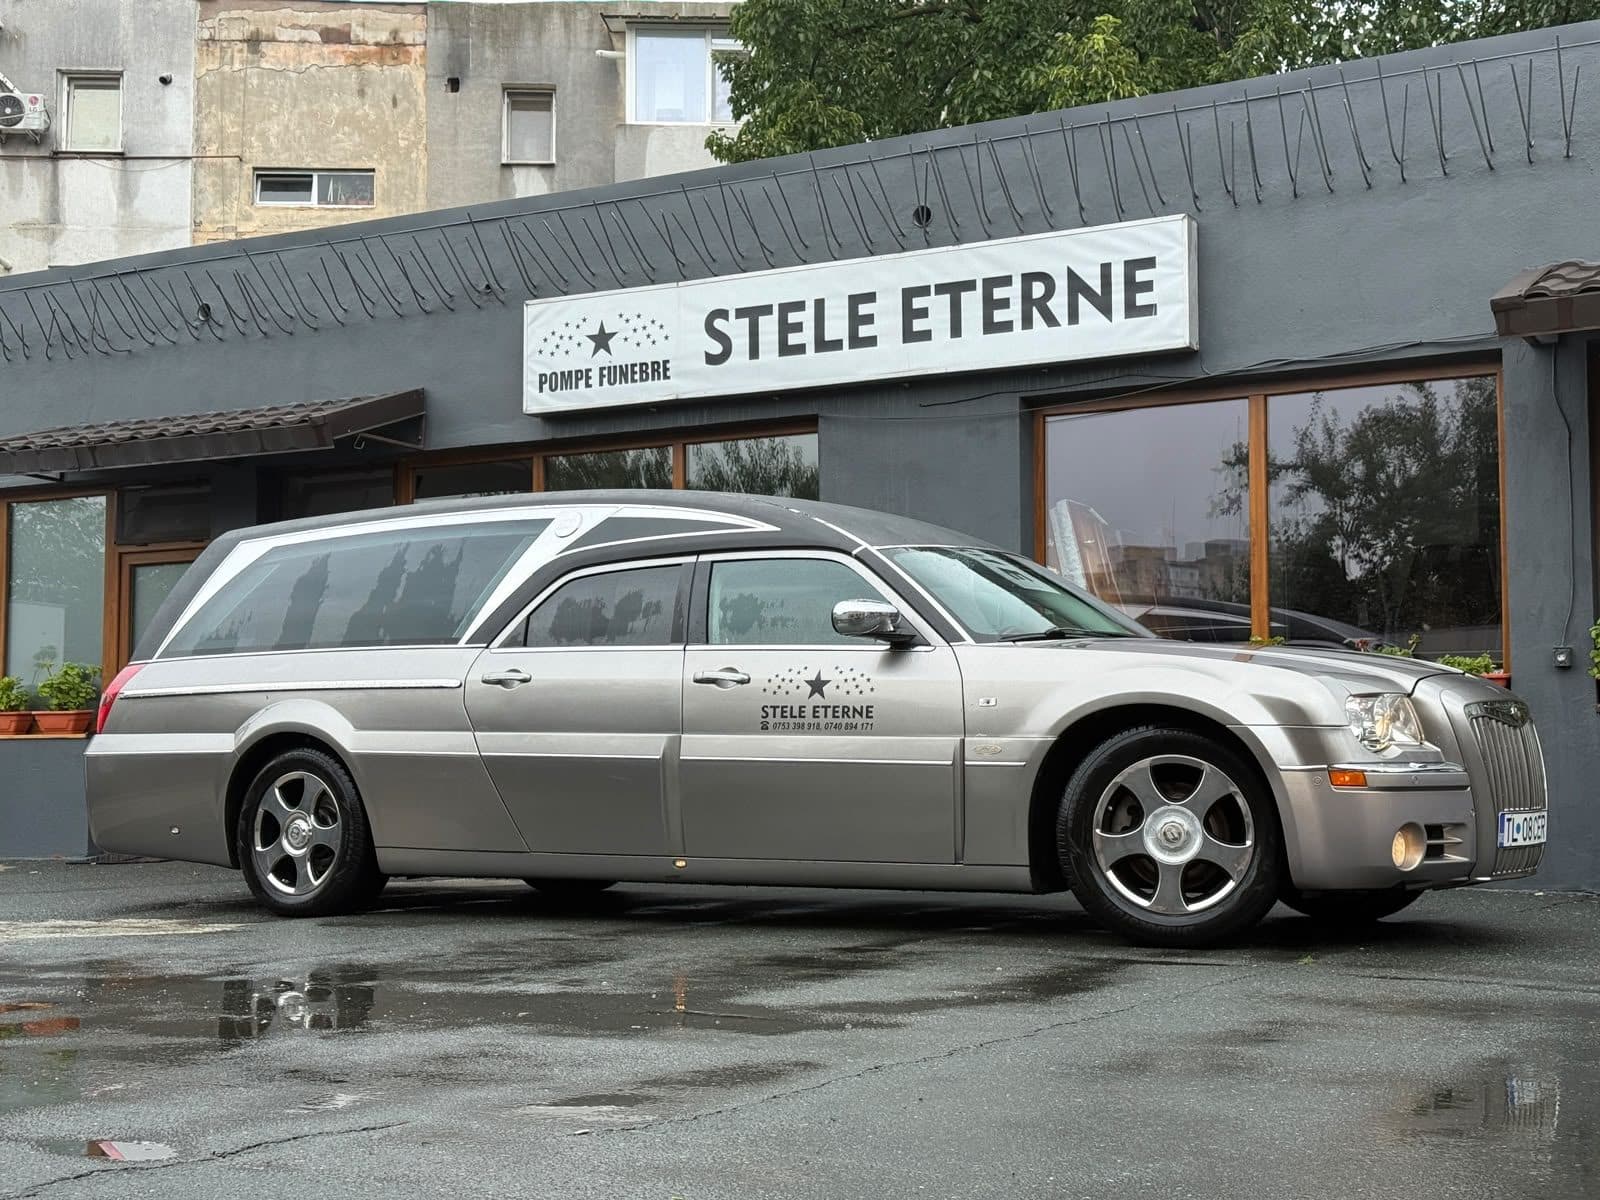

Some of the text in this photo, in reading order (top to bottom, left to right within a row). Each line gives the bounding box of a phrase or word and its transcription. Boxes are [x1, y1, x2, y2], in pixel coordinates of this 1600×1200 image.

[703, 256, 1158, 367] STELE ETERNE
[538, 359, 671, 394] POMPE FUNEBRE
[761, 705, 875, 719] STELE ETERNE
[772, 722, 790, 730] 0753
[792, 722, 806, 730] 398
[824, 722, 842, 730] 0740
[844, 722, 858, 730] 894
[860, 722, 874, 730] 171
